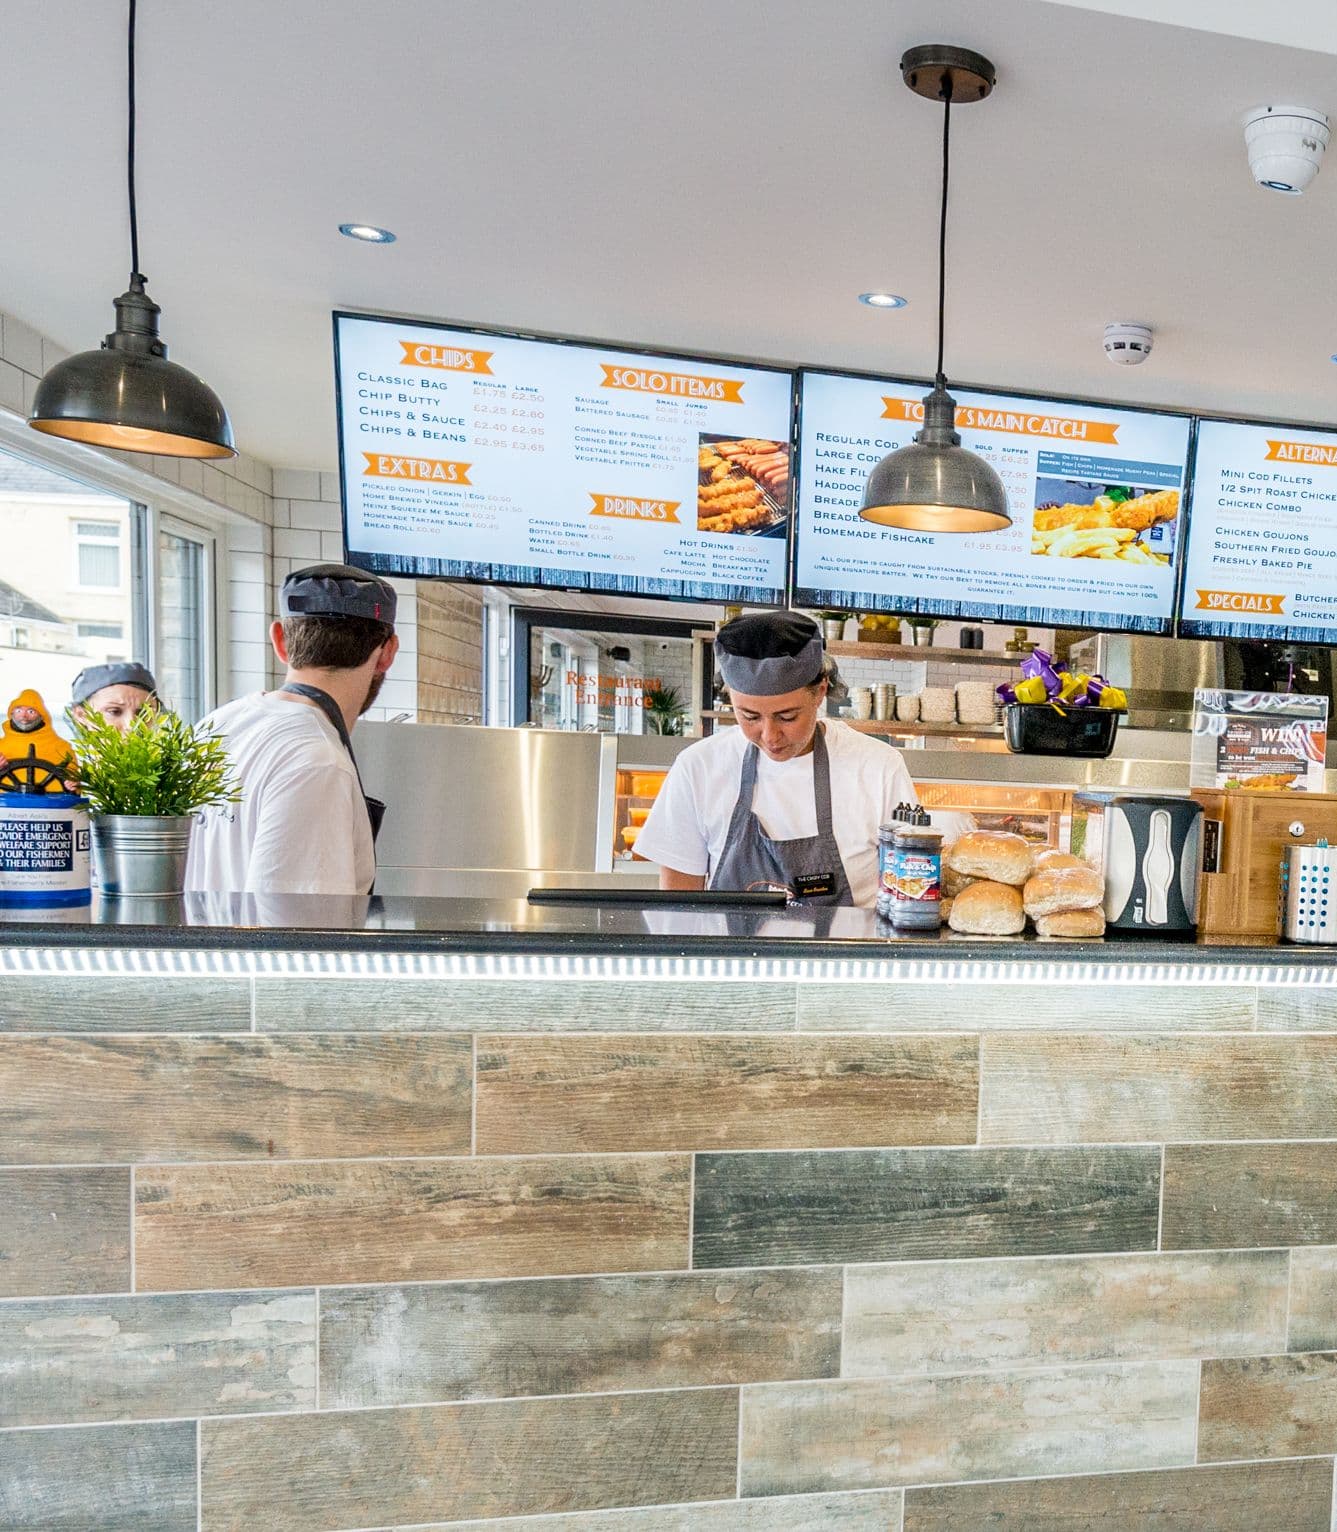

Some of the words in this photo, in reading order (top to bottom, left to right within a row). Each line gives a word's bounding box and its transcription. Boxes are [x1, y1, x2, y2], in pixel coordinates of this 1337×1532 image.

[414, 346, 475, 369] CHIPS
[357, 372, 414, 386] CLASSIC
[420, 379, 447, 390] BAG
[612, 369, 667, 391] SOLO
[670, 376, 725, 399] ITEMS
[358, 389, 392, 400] CHIP
[398, 393, 440, 406] BUTTY
[359, 406, 401, 418] CHIPS
[406, 411, 415, 420] &
[421, 413, 465, 425] SAUCE
[359, 423, 401, 435] CHIPS
[406, 428, 416, 437] &
[422, 430, 466, 442] BEANS
[978, 411, 1026, 432] MAIN
[1026, 416, 1088, 439] CATCH
[816, 432, 870, 446] REGULAR
[874, 438, 899, 450] COD
[815, 449, 852, 460] LARGE
[378, 456, 458, 481] EXTRAS
[815, 464, 845, 475] HAKE
[1221, 469, 1244, 478] MINI
[1248, 472, 1269, 481] COD
[1272, 474, 1312, 484] FILLETS
[1239, 485, 1262, 494] SPIT
[1265, 488, 1297, 498] ROAST
[604, 497, 667, 519] DRINKS
[1218, 498, 1262, 509] CHICKEN
[1265, 502, 1301, 512] COMBO
[813, 526, 876, 539] HOMEMADE
[881, 532, 934, 544] FISHCAKE
[1215, 527, 1259, 537] CHICKEN
[1262, 531, 1309, 541] GOUJONS
[700, 541, 734, 550] DRINKS
[1214, 541, 1267, 552] SOUTHERN
[1271, 545, 1300, 554] FRIED
[1212, 555, 1257, 565] FRESHLY
[1261, 559, 1293, 568] BAKED
[1296, 561, 1312, 569] PIE
[1206, 592, 1273, 612] SPECIALS
[1292, 610, 1335, 619] CHICKEN
[566, 670, 662, 690] Restaurant
[576, 688, 654, 710] Entrance
[0, 823, 29, 832] PLEASE
[30, 823, 51, 832] HELP
[53, 823, 64, 832] US
[0, 832, 23, 841] OVIDE
[25, 832, 73, 841] EMERGENCY
[36, 841, 71, 850] SUPPORT
[5, 850, 24, 859] OUR
[26, 850, 70, 859] FISHERMEN
[6, 860, 30, 868] THEIR
[31, 860, 66, 868] FAMILIES
